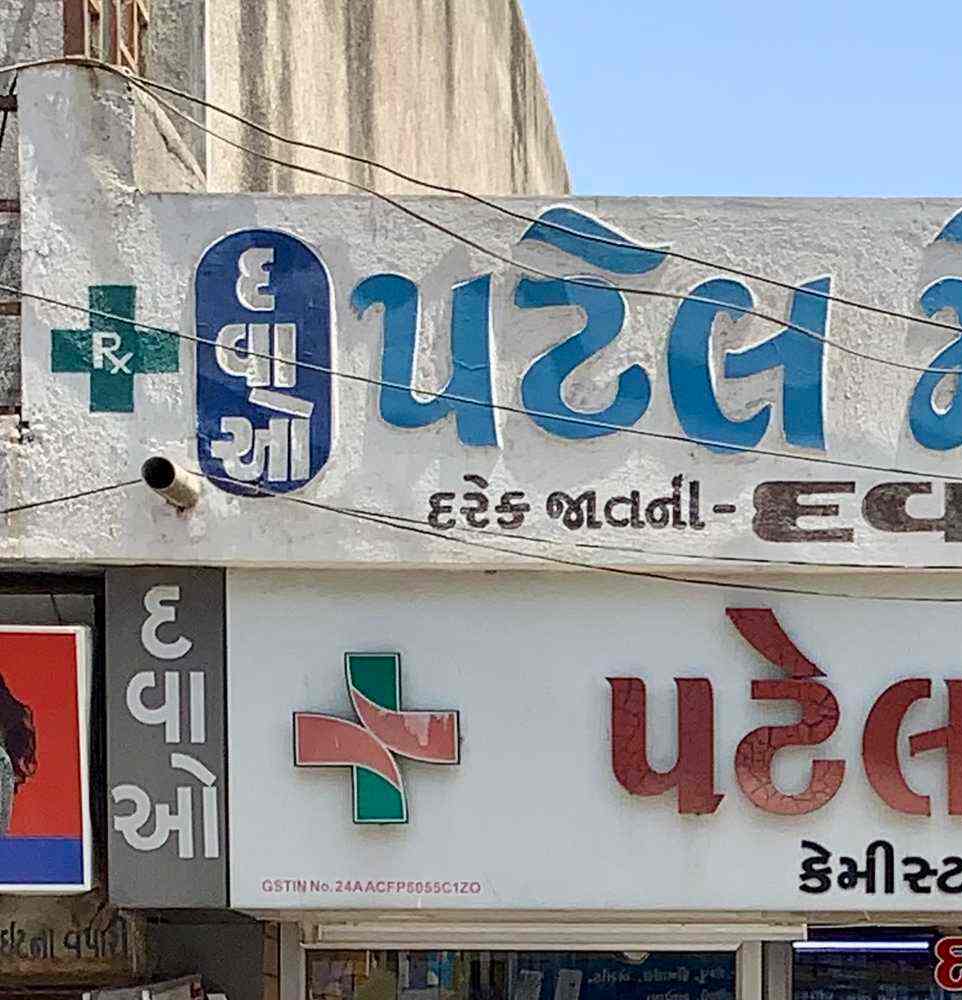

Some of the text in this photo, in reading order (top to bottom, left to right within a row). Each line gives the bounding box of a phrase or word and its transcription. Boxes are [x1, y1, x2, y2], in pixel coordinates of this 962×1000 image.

[209, 246, 315, 483] દવાઓ
[349, 205, 831, 453] પટેલ
[427, 473, 531, 531] દરેક
[110, 585, 220, 859] દવાઓ
[261, 879, 307, 893] GSTIN
[309, 880, 334, 893] No.
